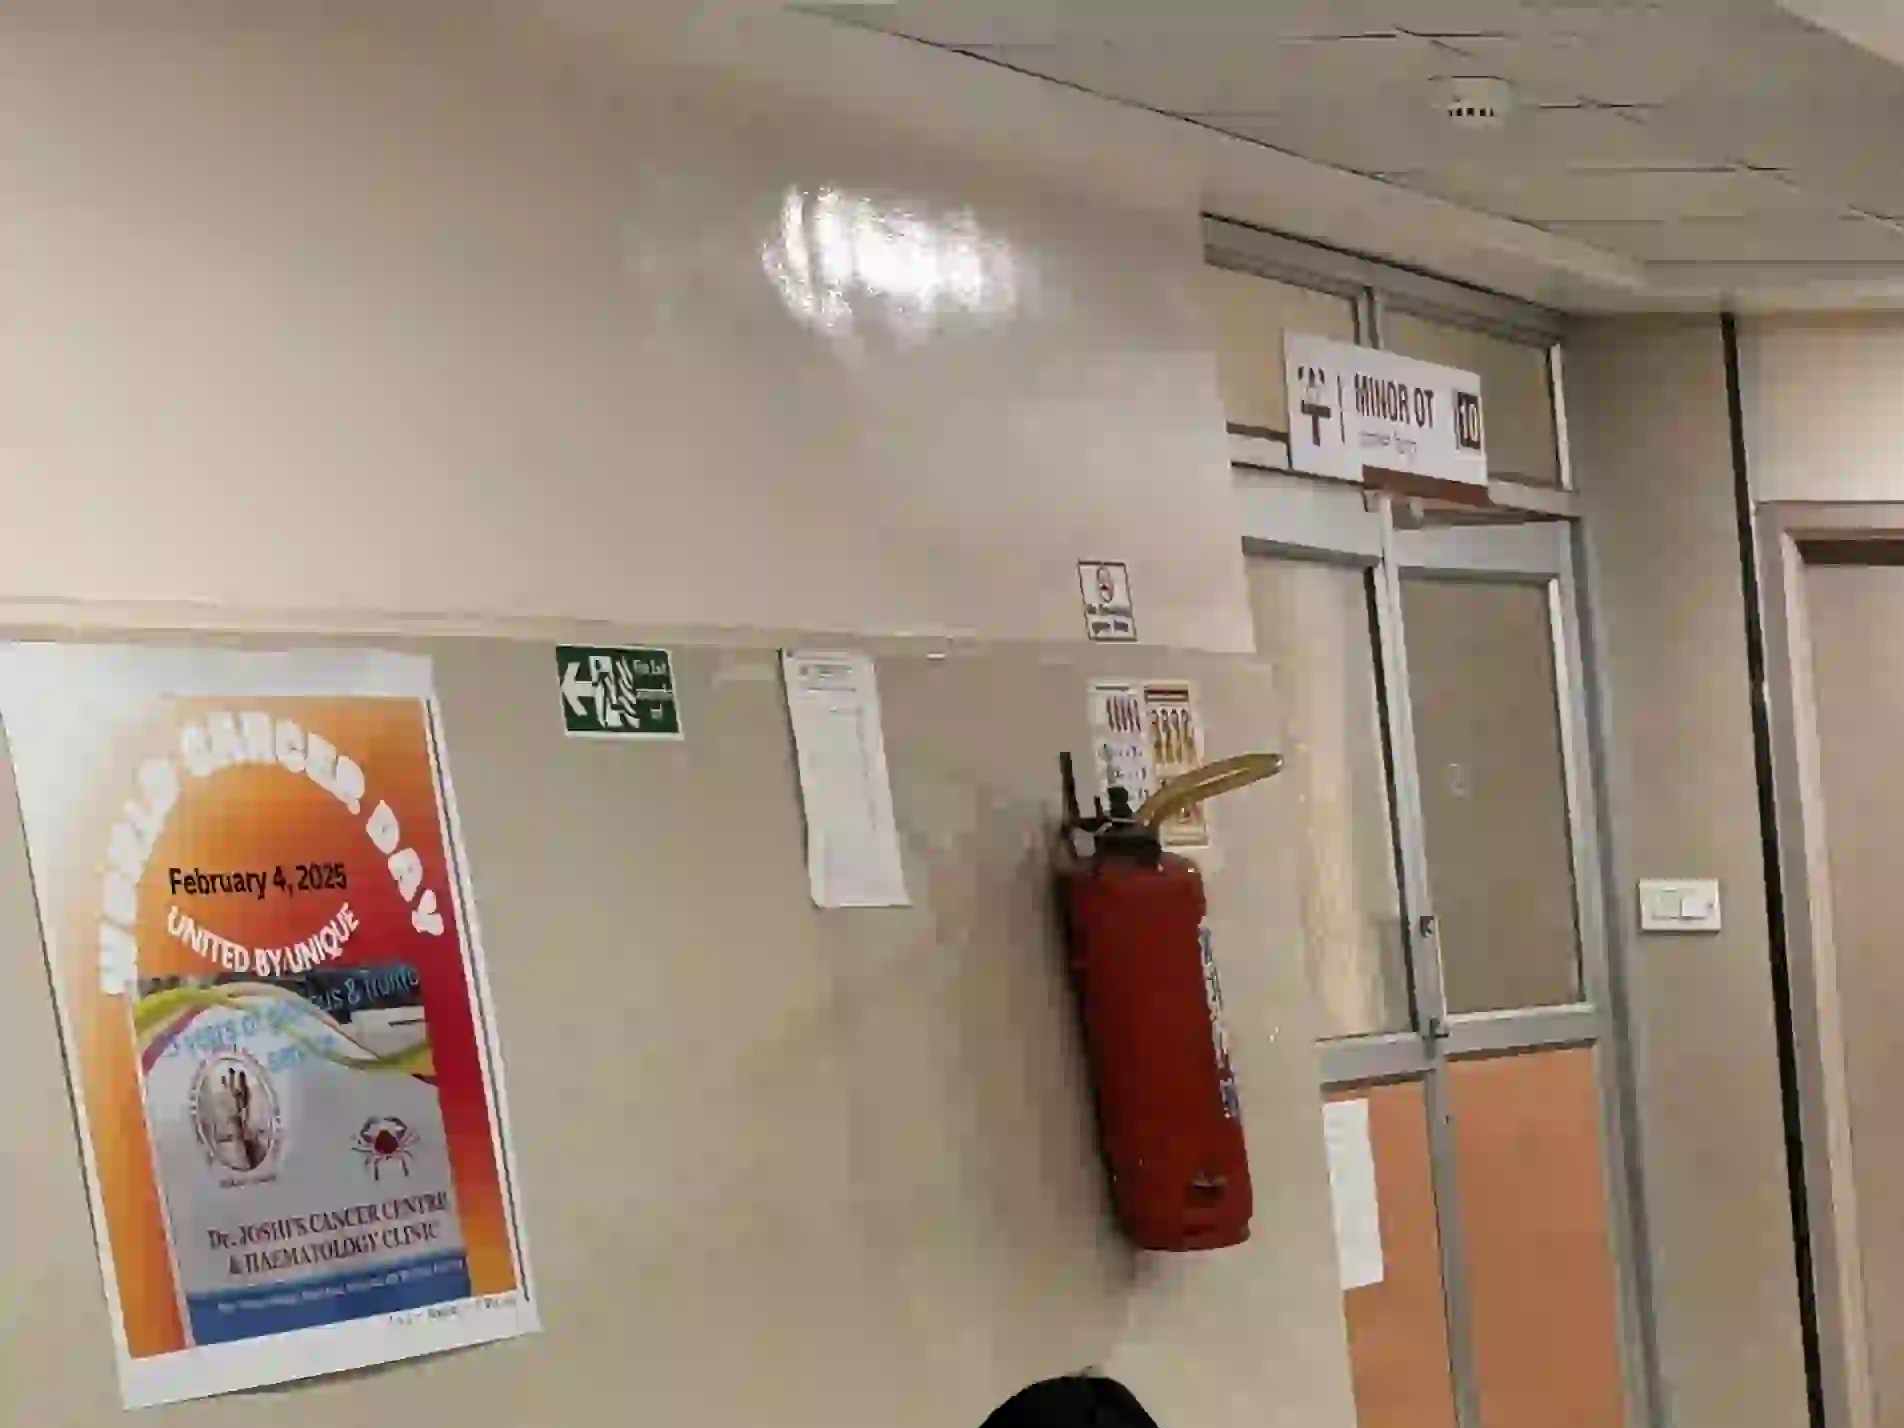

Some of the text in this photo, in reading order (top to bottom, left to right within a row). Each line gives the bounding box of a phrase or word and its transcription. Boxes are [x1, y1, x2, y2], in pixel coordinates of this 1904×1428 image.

[1354, 372, 1411, 425] MINOR
[1415, 388, 1435, 429] OT
[1459, 401, 1480, 443] 10
[168, 862, 348, 901] February 4, 2025
[166, 901, 361, 978] UNITED BY UNIQUE
[309, 1204, 381, 1233] CANCER
